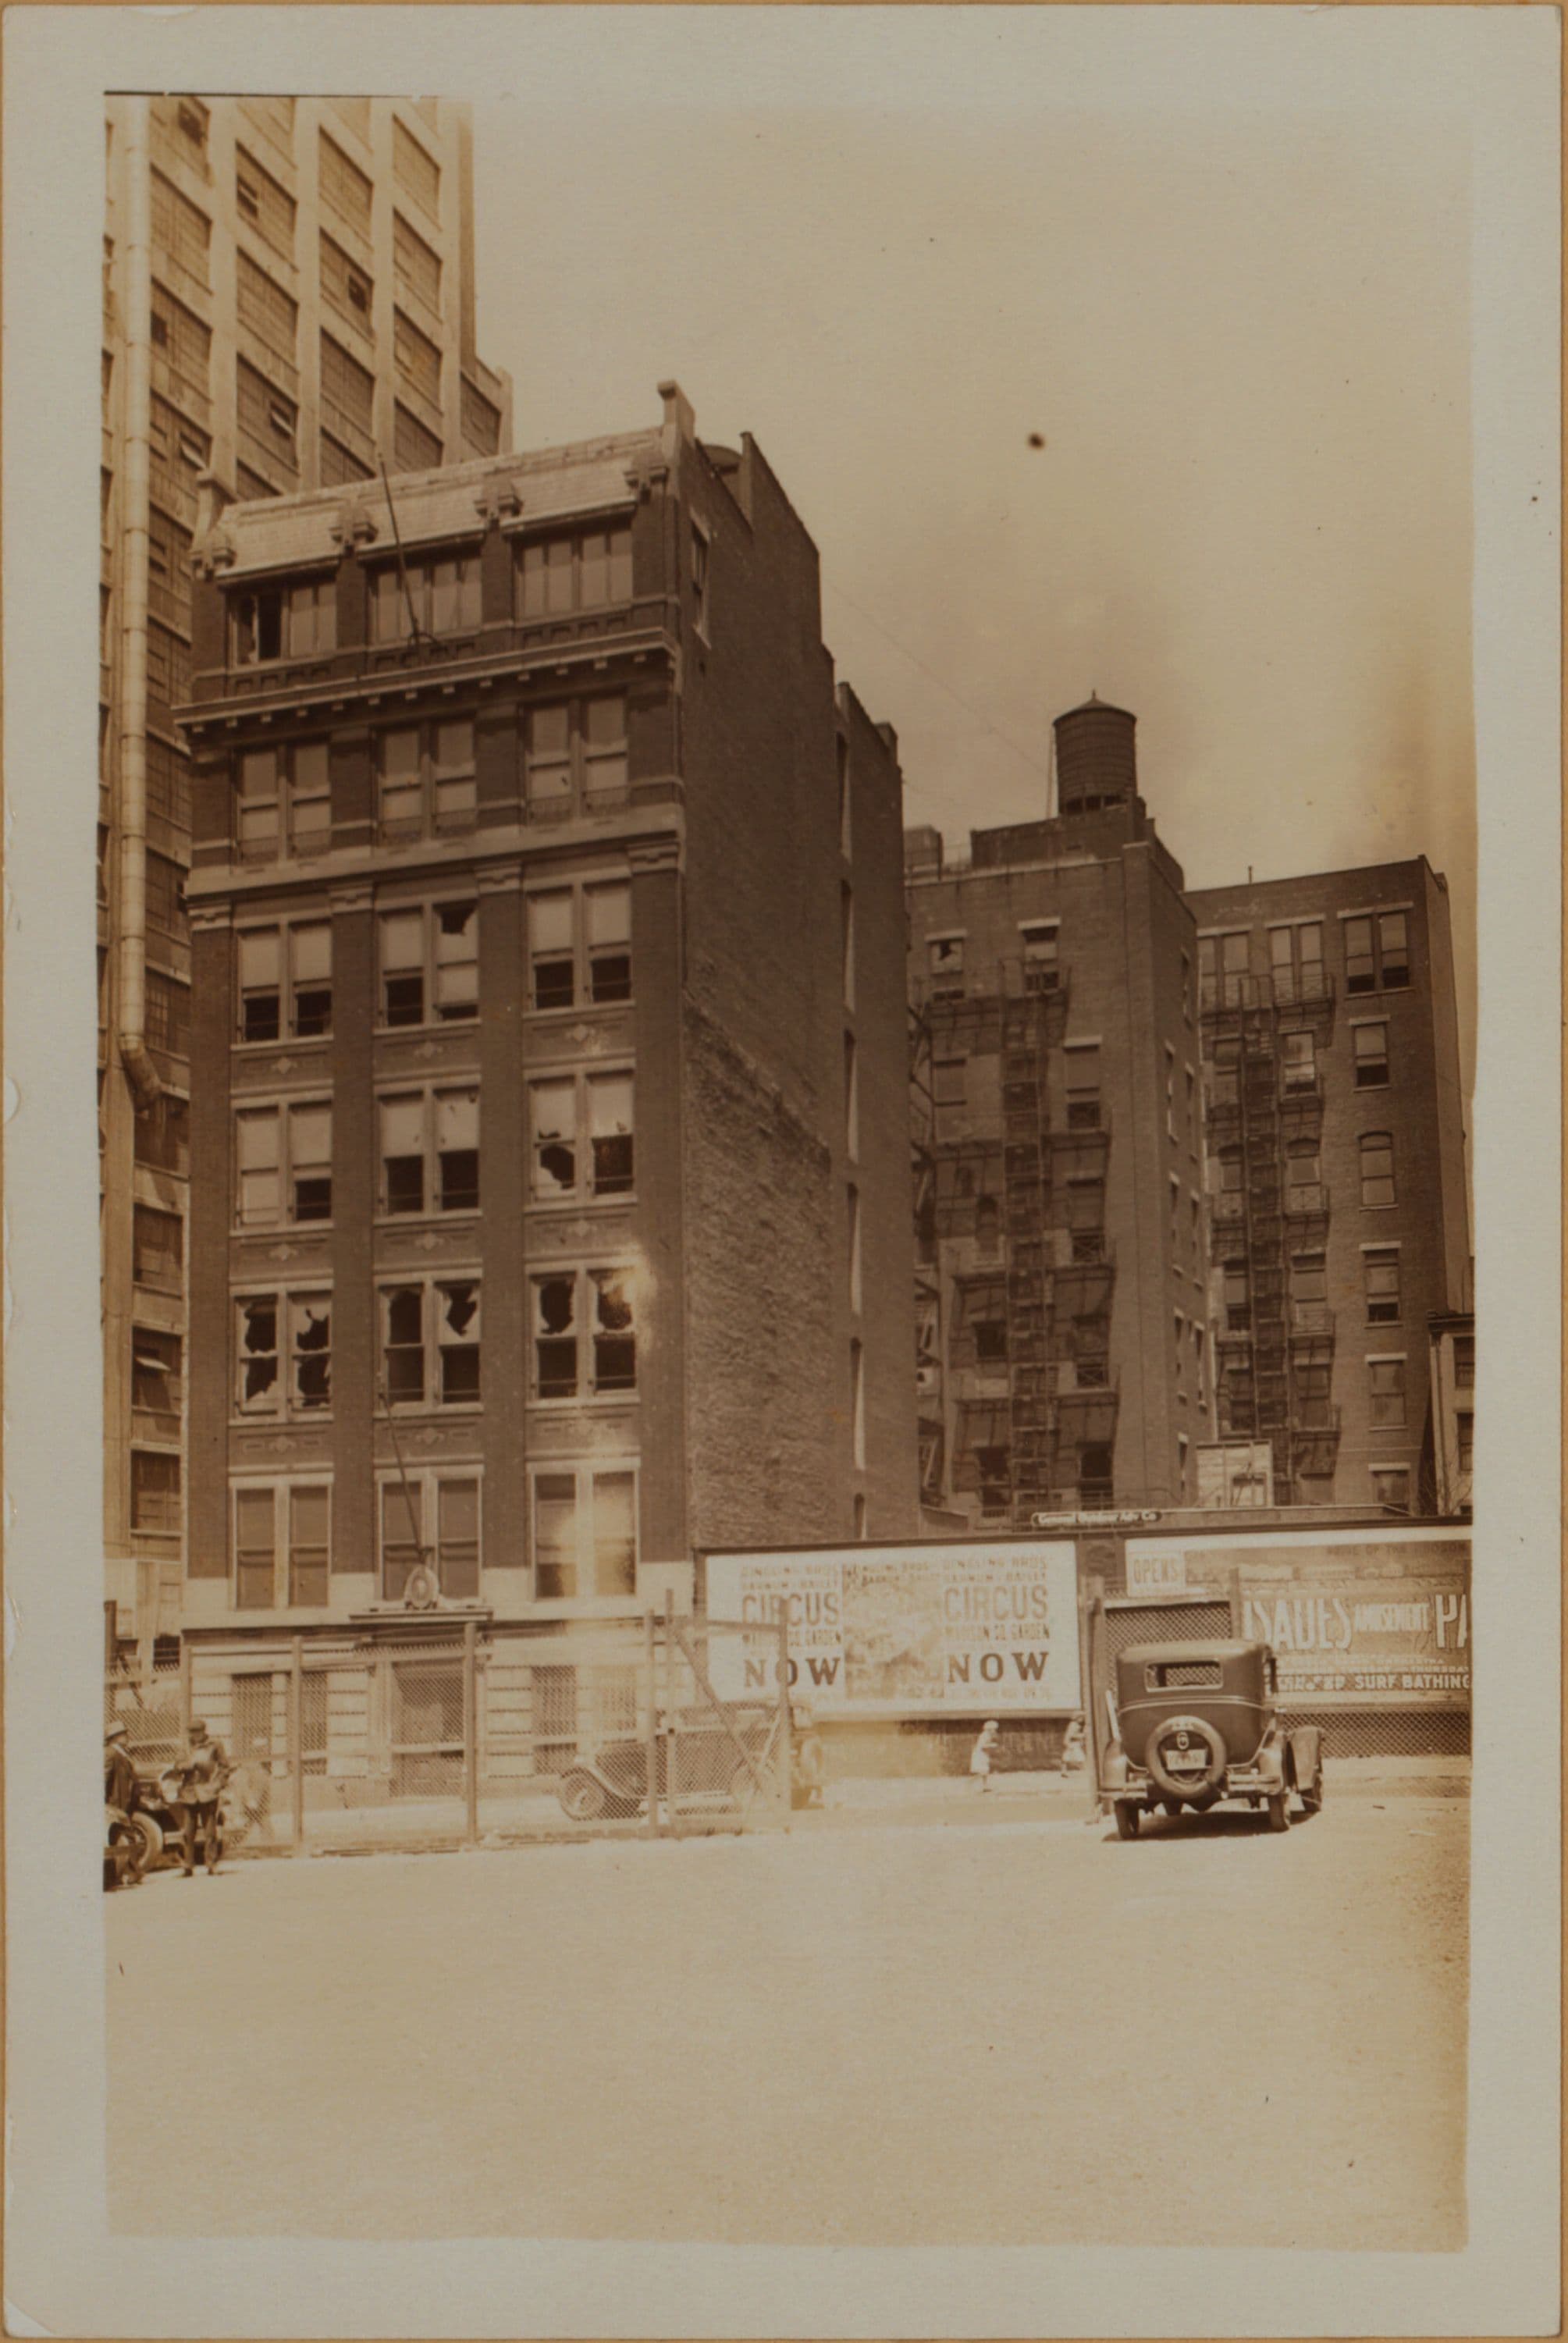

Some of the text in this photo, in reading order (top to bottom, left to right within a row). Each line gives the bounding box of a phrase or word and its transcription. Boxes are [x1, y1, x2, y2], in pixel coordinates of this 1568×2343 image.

[742, 1592, 839, 1628] CIRCUS
[944, 1584, 1049, 1623] CIRCUS
[743, 1657, 841, 1688] NOW
[948, 1651, 1050, 1683] NOW
[1354, 1674, 1397, 1690] SURF
[1402, 1673, 1470, 1689] BATHING
